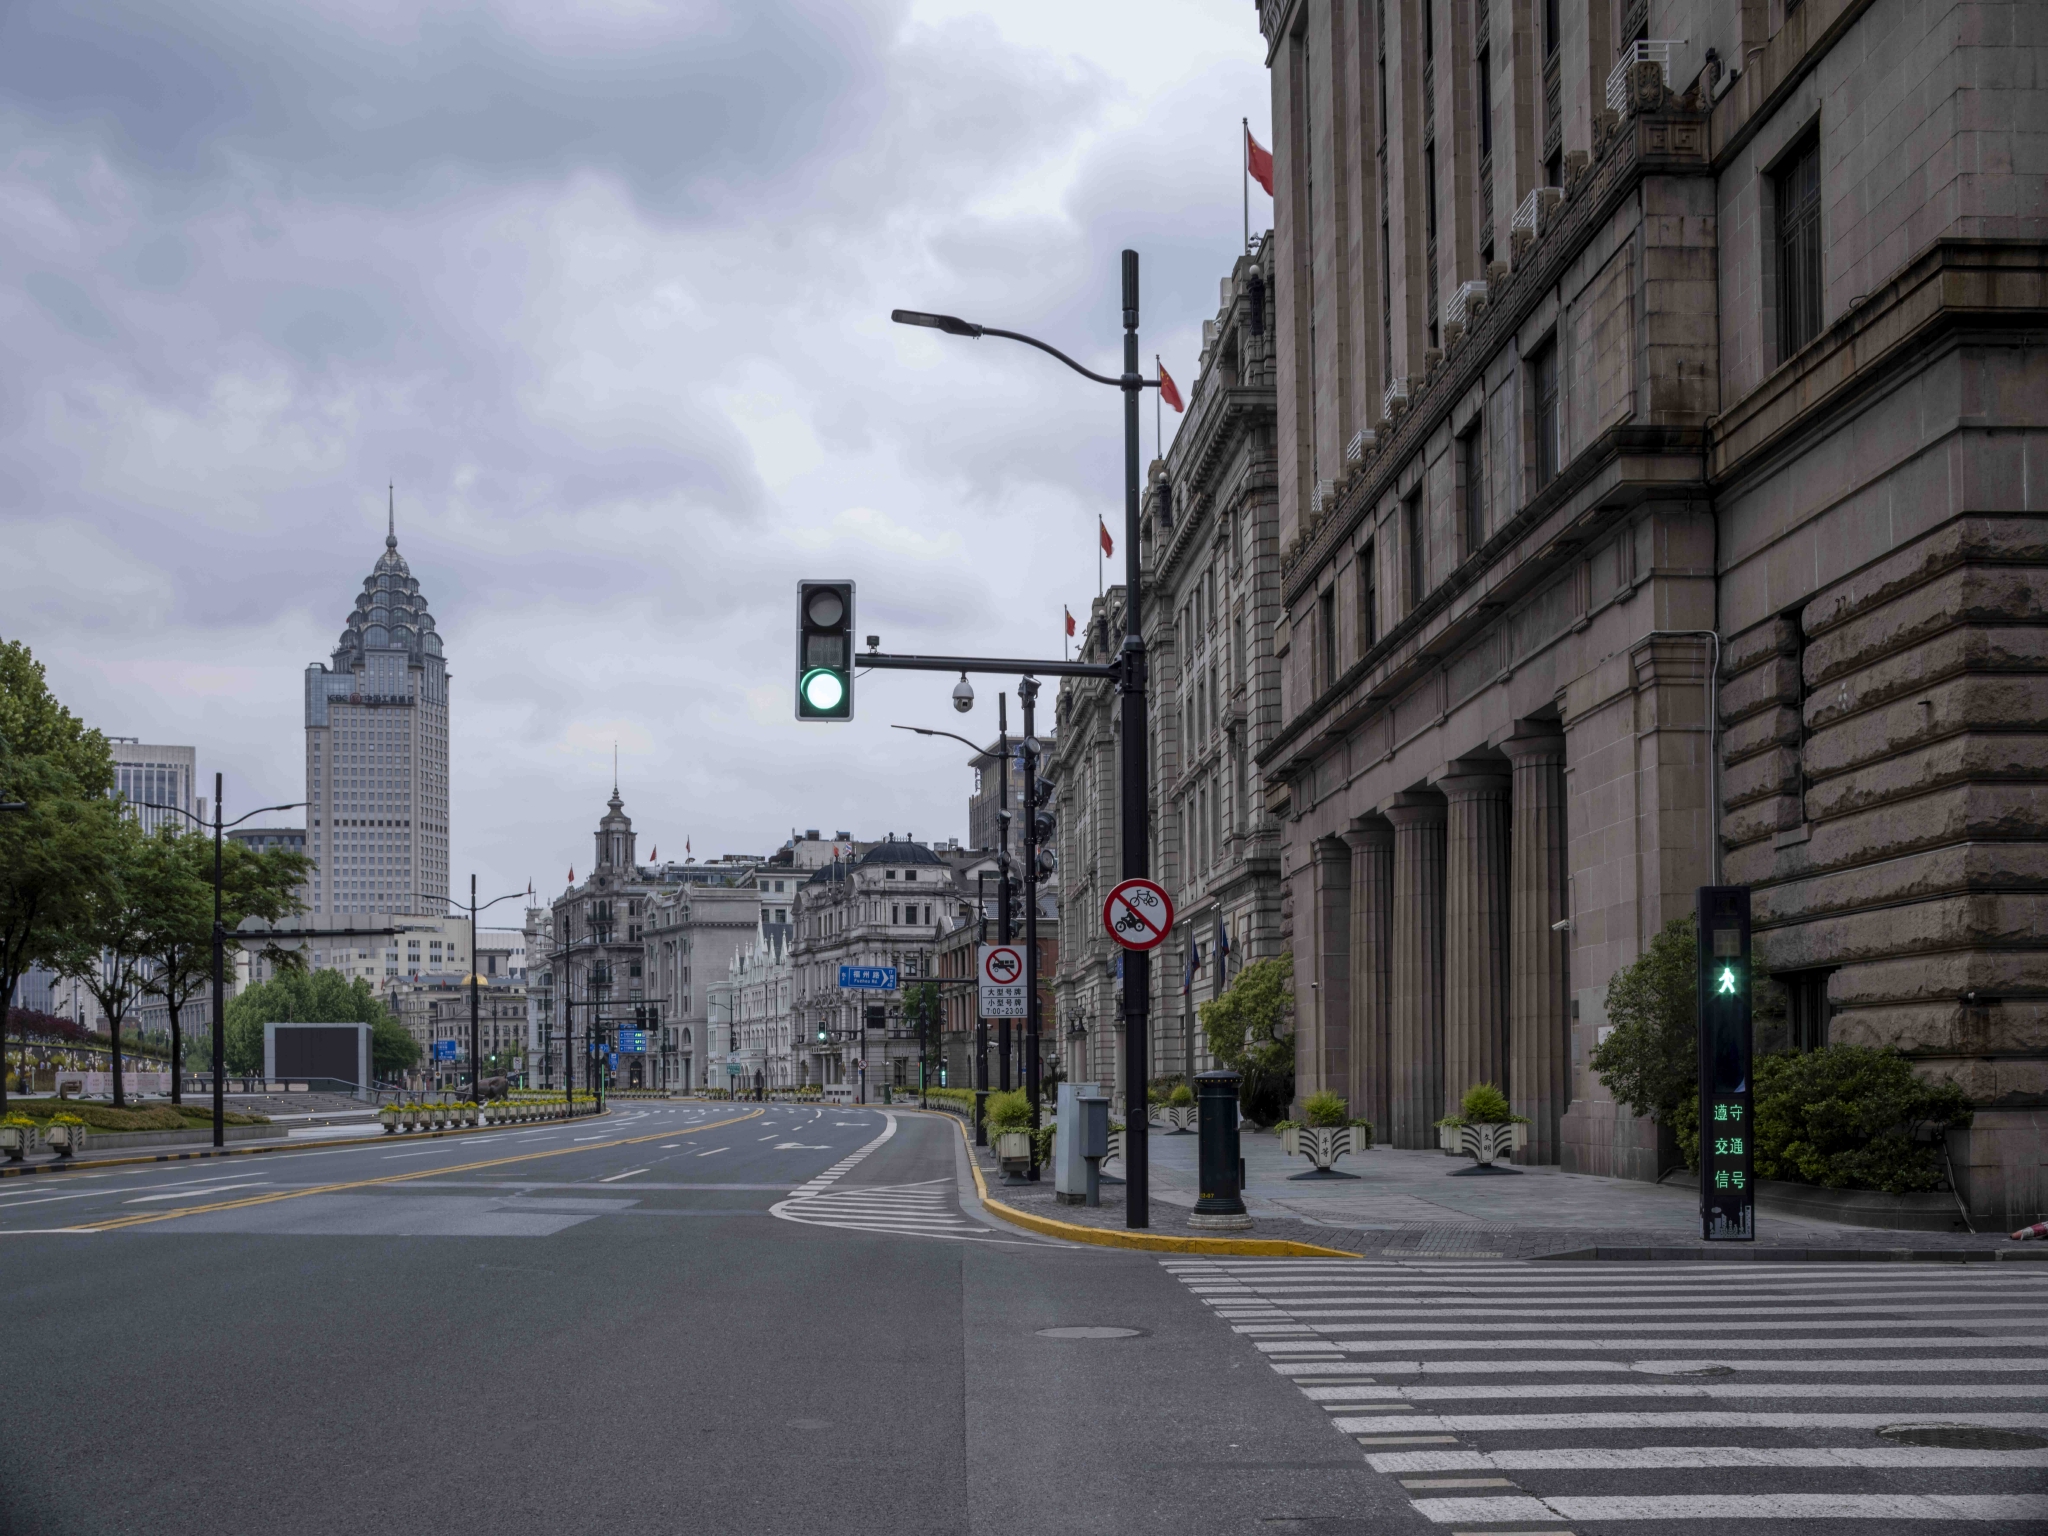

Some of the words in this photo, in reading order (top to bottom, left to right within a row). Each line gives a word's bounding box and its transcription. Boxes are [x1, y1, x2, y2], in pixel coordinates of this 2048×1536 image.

[365, 694, 414, 703] 中国工商银行
[853, 970, 879, 978] 福州路
[988, 988, 1021, 996] 大型号牌
[1714, 1104, 1743, 1121] 遵守
[1320, 1136, 1330, 1158] 平等
[1483, 1133, 1492, 1153] 文明
[1715, 1138, 1743, 1155] 交通
[1715, 1170, 1746, 1189] 信号
